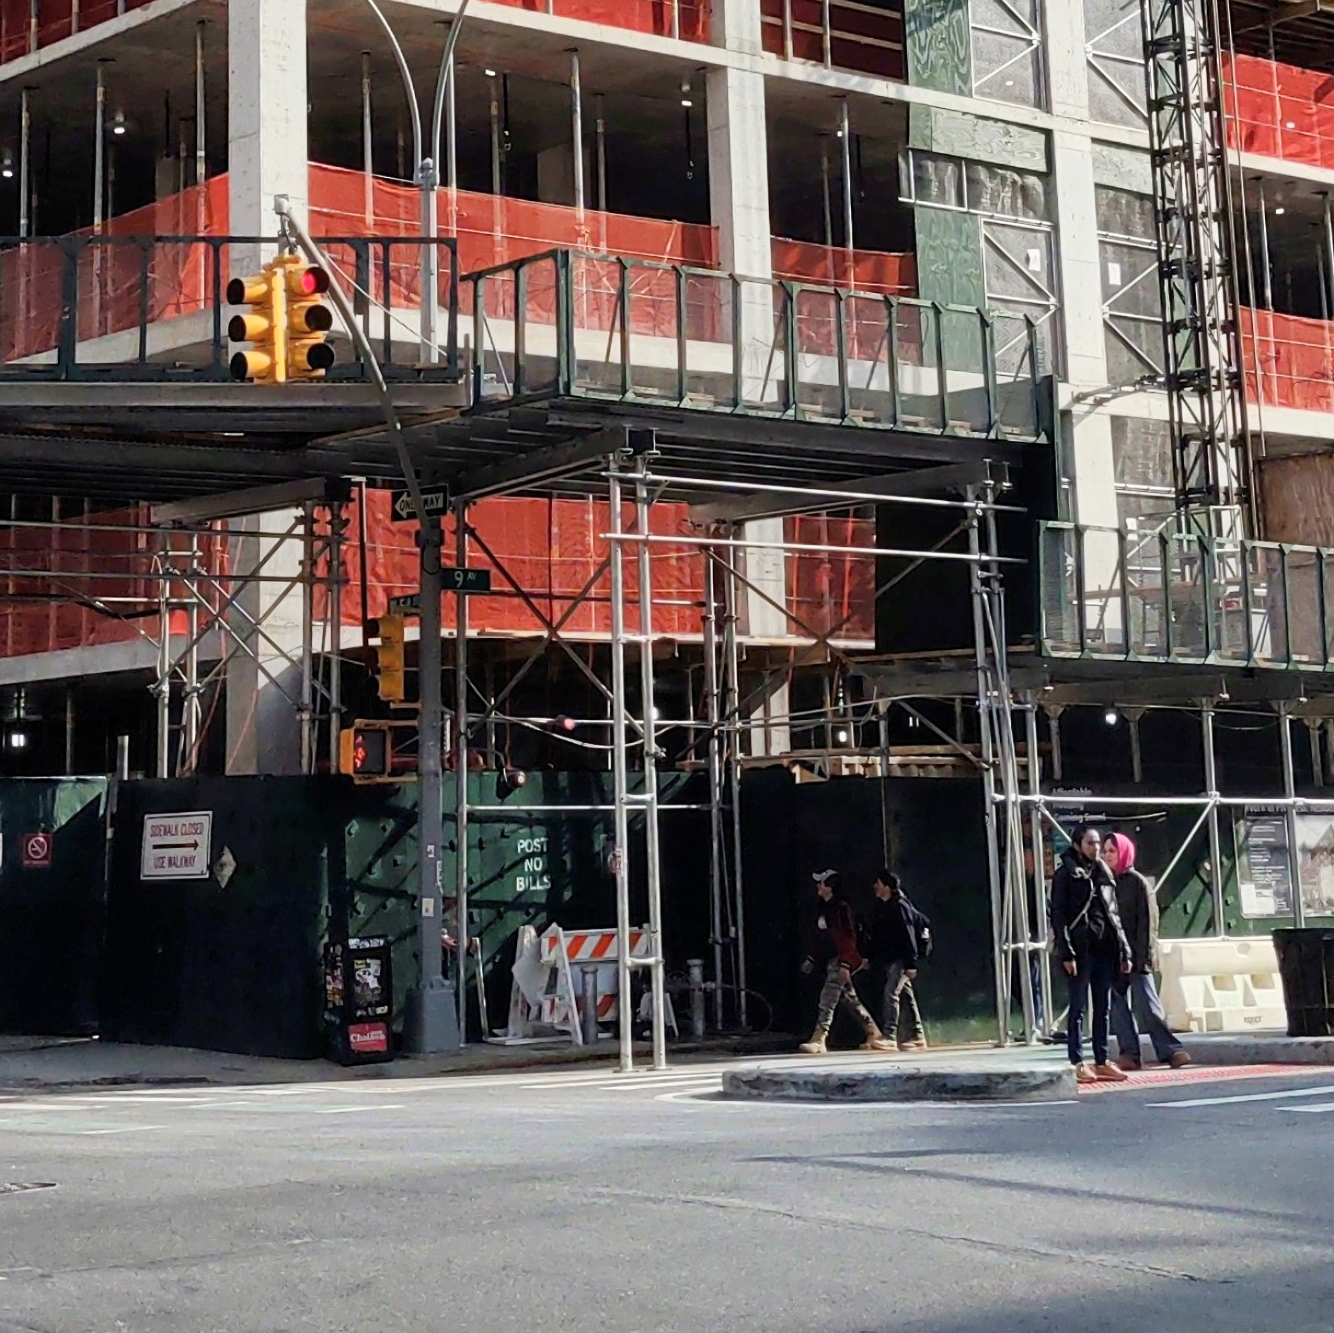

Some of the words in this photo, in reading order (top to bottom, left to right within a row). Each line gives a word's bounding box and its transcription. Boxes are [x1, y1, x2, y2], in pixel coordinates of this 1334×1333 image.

[454, 570, 464, 588] 9
[467, 571, 476, 581] AV
[517, 837, 548, 854] POST
[524, 857, 542, 872] NO
[516, 874, 551, 892] BILLS
